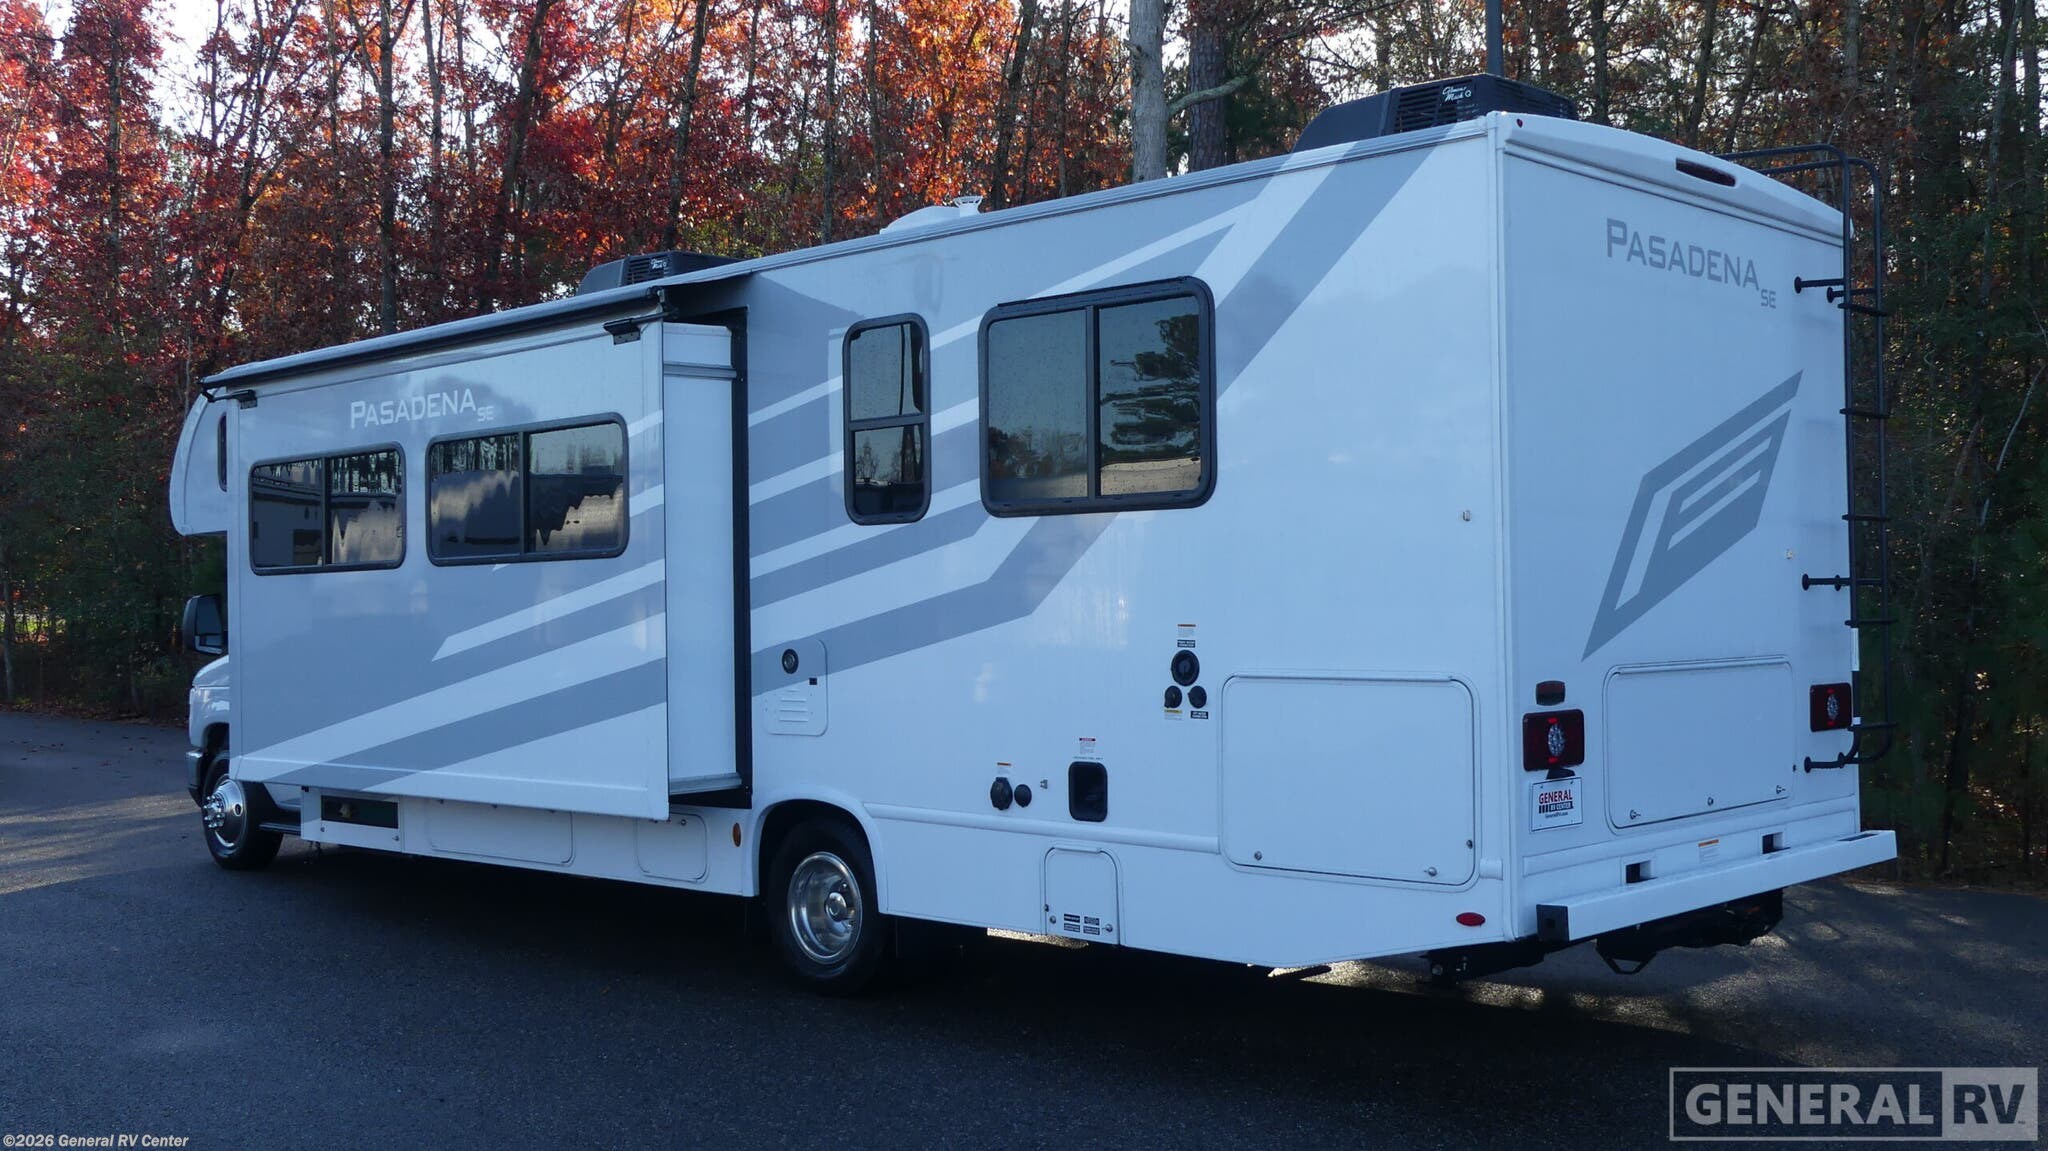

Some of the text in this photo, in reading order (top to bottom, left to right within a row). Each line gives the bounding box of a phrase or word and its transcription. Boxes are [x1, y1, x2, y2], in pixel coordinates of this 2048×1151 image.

[1607, 218, 1777, 309] PASADENA SE
[350, 388, 495, 430] PASADENA SE
[1538, 789, 1573, 804] GENERAL
